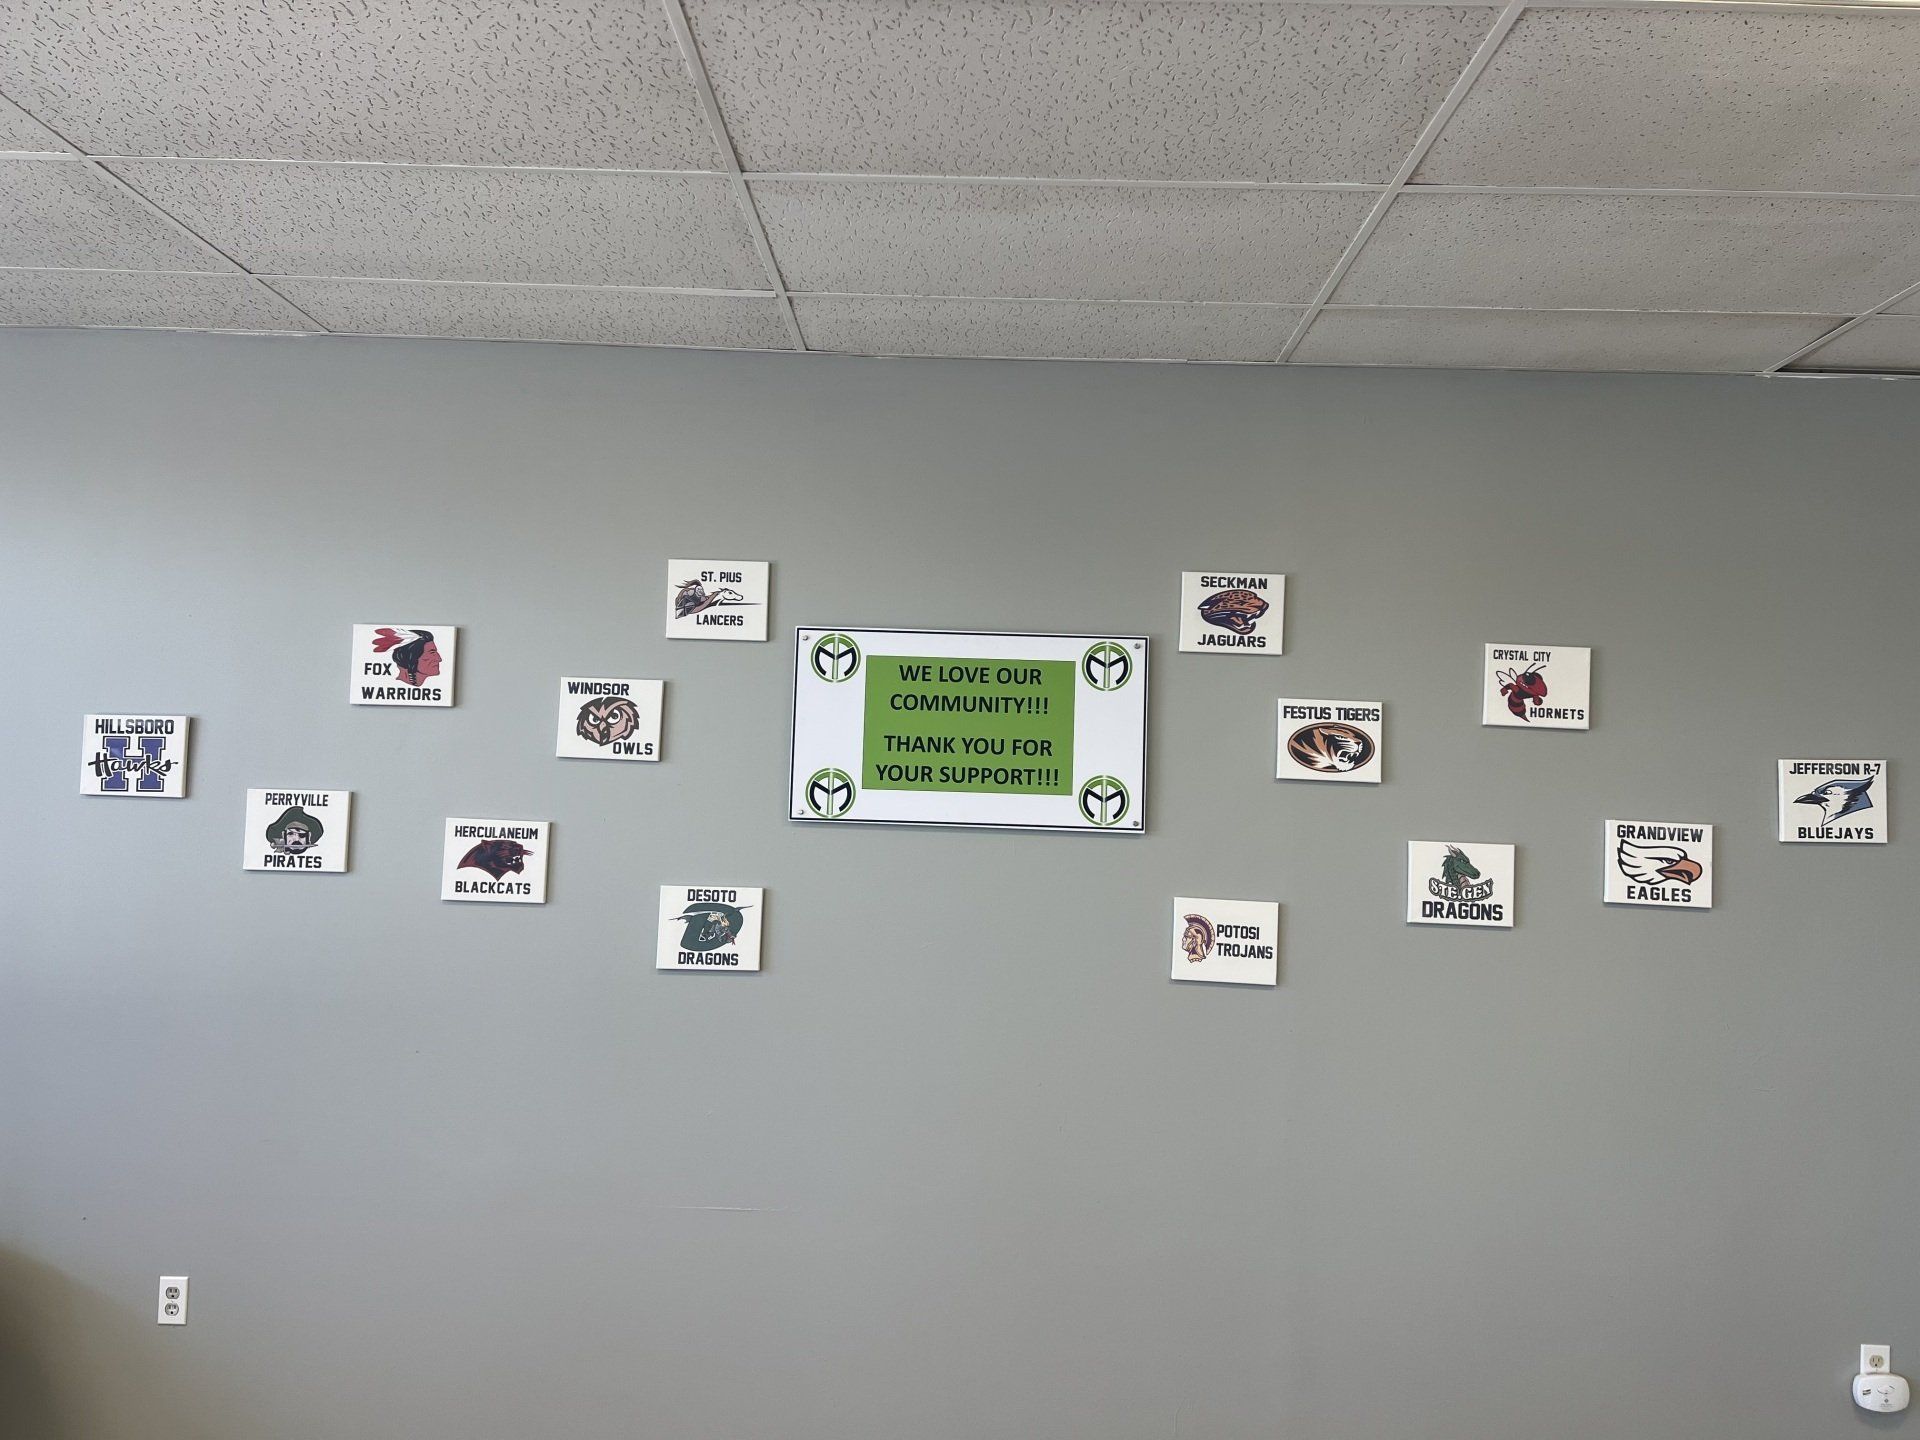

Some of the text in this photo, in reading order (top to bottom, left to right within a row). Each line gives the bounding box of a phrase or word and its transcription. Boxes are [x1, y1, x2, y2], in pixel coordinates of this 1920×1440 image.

[701, 571, 742, 583] ST. PIUS
[1201, 576, 1268, 589] SECKMAN
[696, 615, 743, 626] LANCERS
[1198, 634, 1266, 648] JAGUARS
[1493, 649, 1551, 662] CRYSTAL CITY
[364, 663, 392, 676] FOX
[899, 664, 1042, 685] WE LOVE OUR
[362, 687, 442, 701] WARRIORS
[568, 681, 630, 696] WINDSOR
[890, 693, 1049, 715] COMMUNITY!!!
[1283, 706, 1380, 722] FESTUS TIGERS
[1530, 707, 1584, 720] HORNETS
[95, 719, 174, 735] HILLSBORO
[613, 742, 653, 755] OWLS
[884, 735, 1053, 757] THANK YOU FOR
[88, 751, 178, 778] Hawks
[1789, 763, 1881, 775] JEFFERSON R-7
[876, 764, 1059, 787] YOUR SUPPORT!!!
[265, 792, 329, 807] PERRYVILLE
[455, 826, 538, 840] HERCULANEUM
[1617, 824, 1703, 843] GRANDVIEW
[1798, 826, 1874, 839] BLUEJAYS
[264, 854, 322, 868] PIRATES
[455, 881, 531, 895] BLACKCATS
[1627, 885, 1692, 902] EAGLES
[687, 889, 737, 902] DESOTO
[1422, 900, 1503, 921] DRAGONS
[1216, 924, 1260, 940] POTOSI
[678, 951, 738, 966] DRAGONS
[1216, 944, 1273, 960] TROJANS
